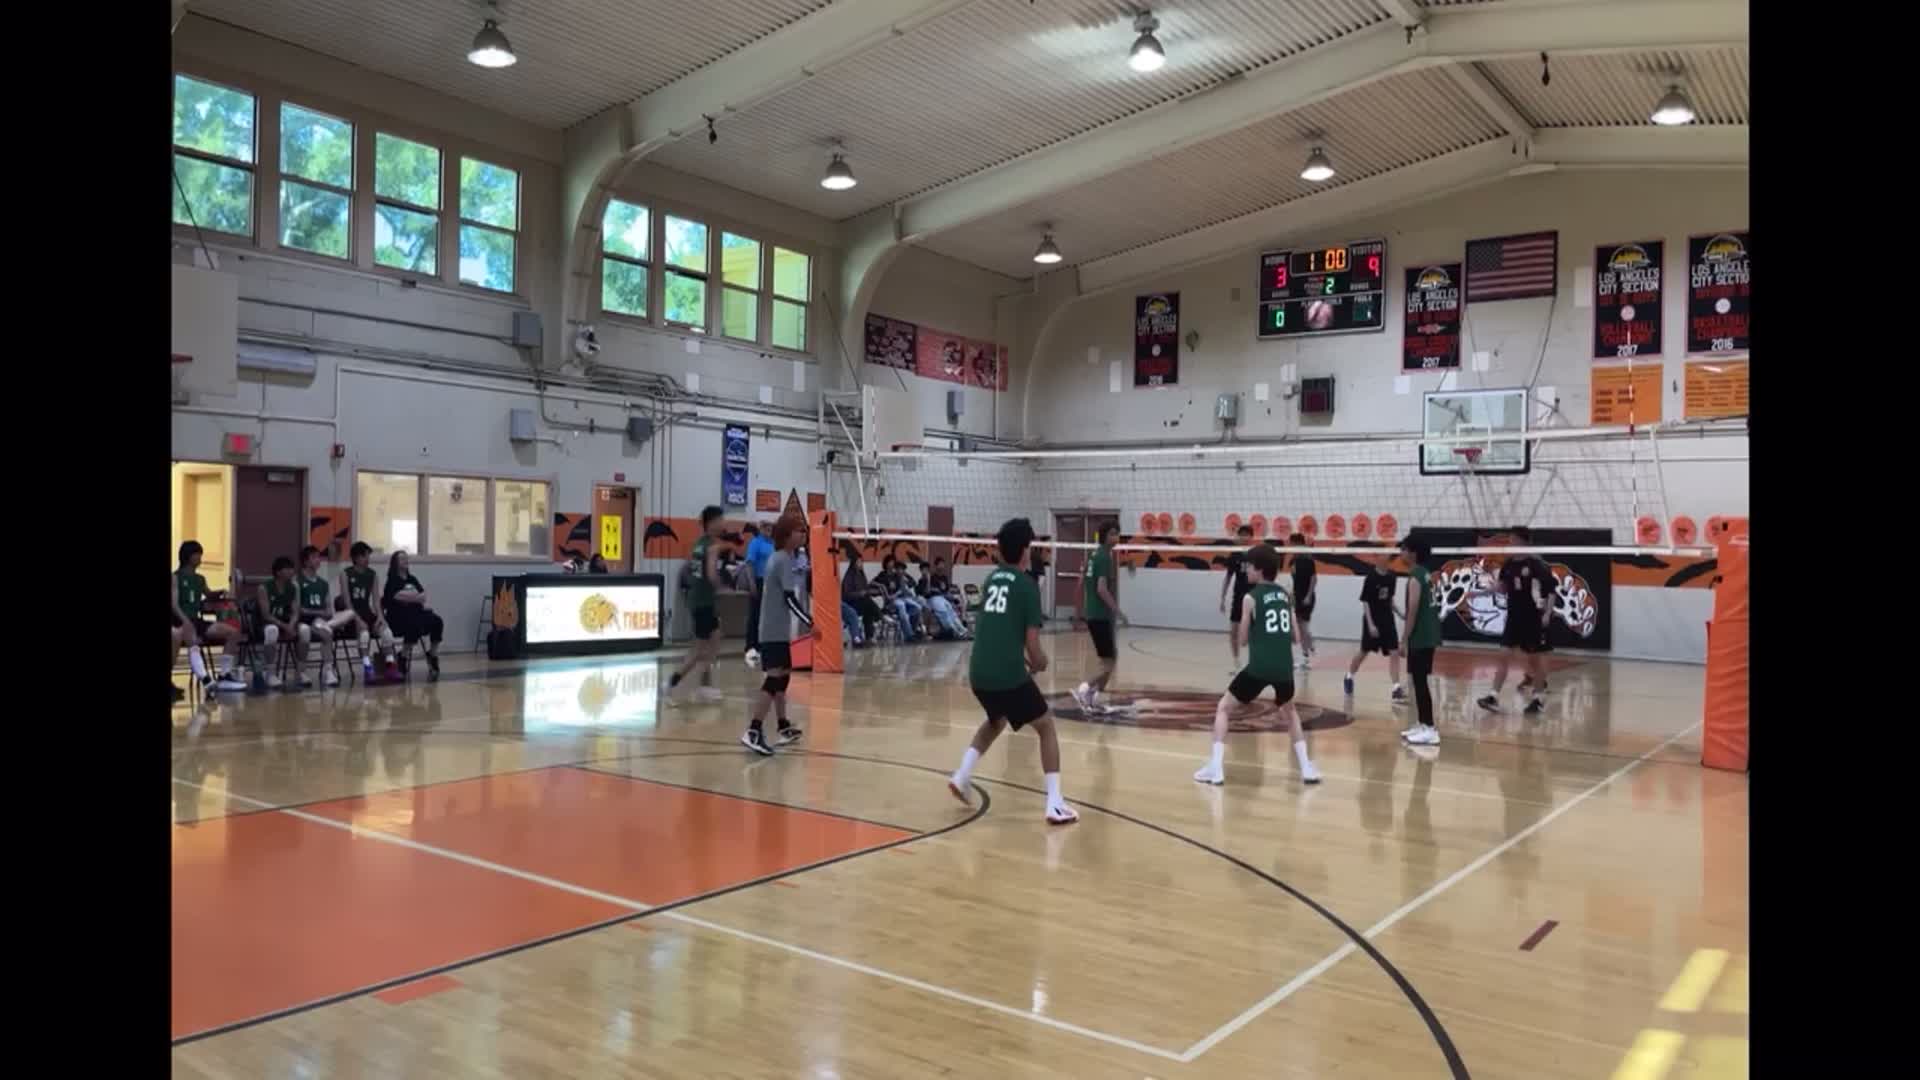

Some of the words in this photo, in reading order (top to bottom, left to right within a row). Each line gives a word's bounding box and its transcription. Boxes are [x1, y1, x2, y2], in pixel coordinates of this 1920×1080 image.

[1310, 253, 1315, 271] 1
[1368, 256, 1379, 277] 9
[1692, 264, 1710, 277] LOS
[1714, 260, 1749, 275] ANGELE
[1276, 266, 1287, 288] 3
[1598, 271, 1616, 284] LOS
[1620, 267, 1659, 281] ANGELES
[1692, 275, 1712, 288] CITY
[1716, 272, 1749, 286] SECTIO
[1325, 277, 1335, 294] 2
[1599, 283, 1618, 296] CITY
[1622, 279, 1659, 293] SECTION
[1276, 311, 1285, 328] 0
[1617, 344, 1638, 357] 2017
[1711, 338, 1734, 351] 2016
[984, 585, 1009, 613] 26
[623, 611, 657, 630] TIGERS
[1265, 609, 1290, 633] 28
